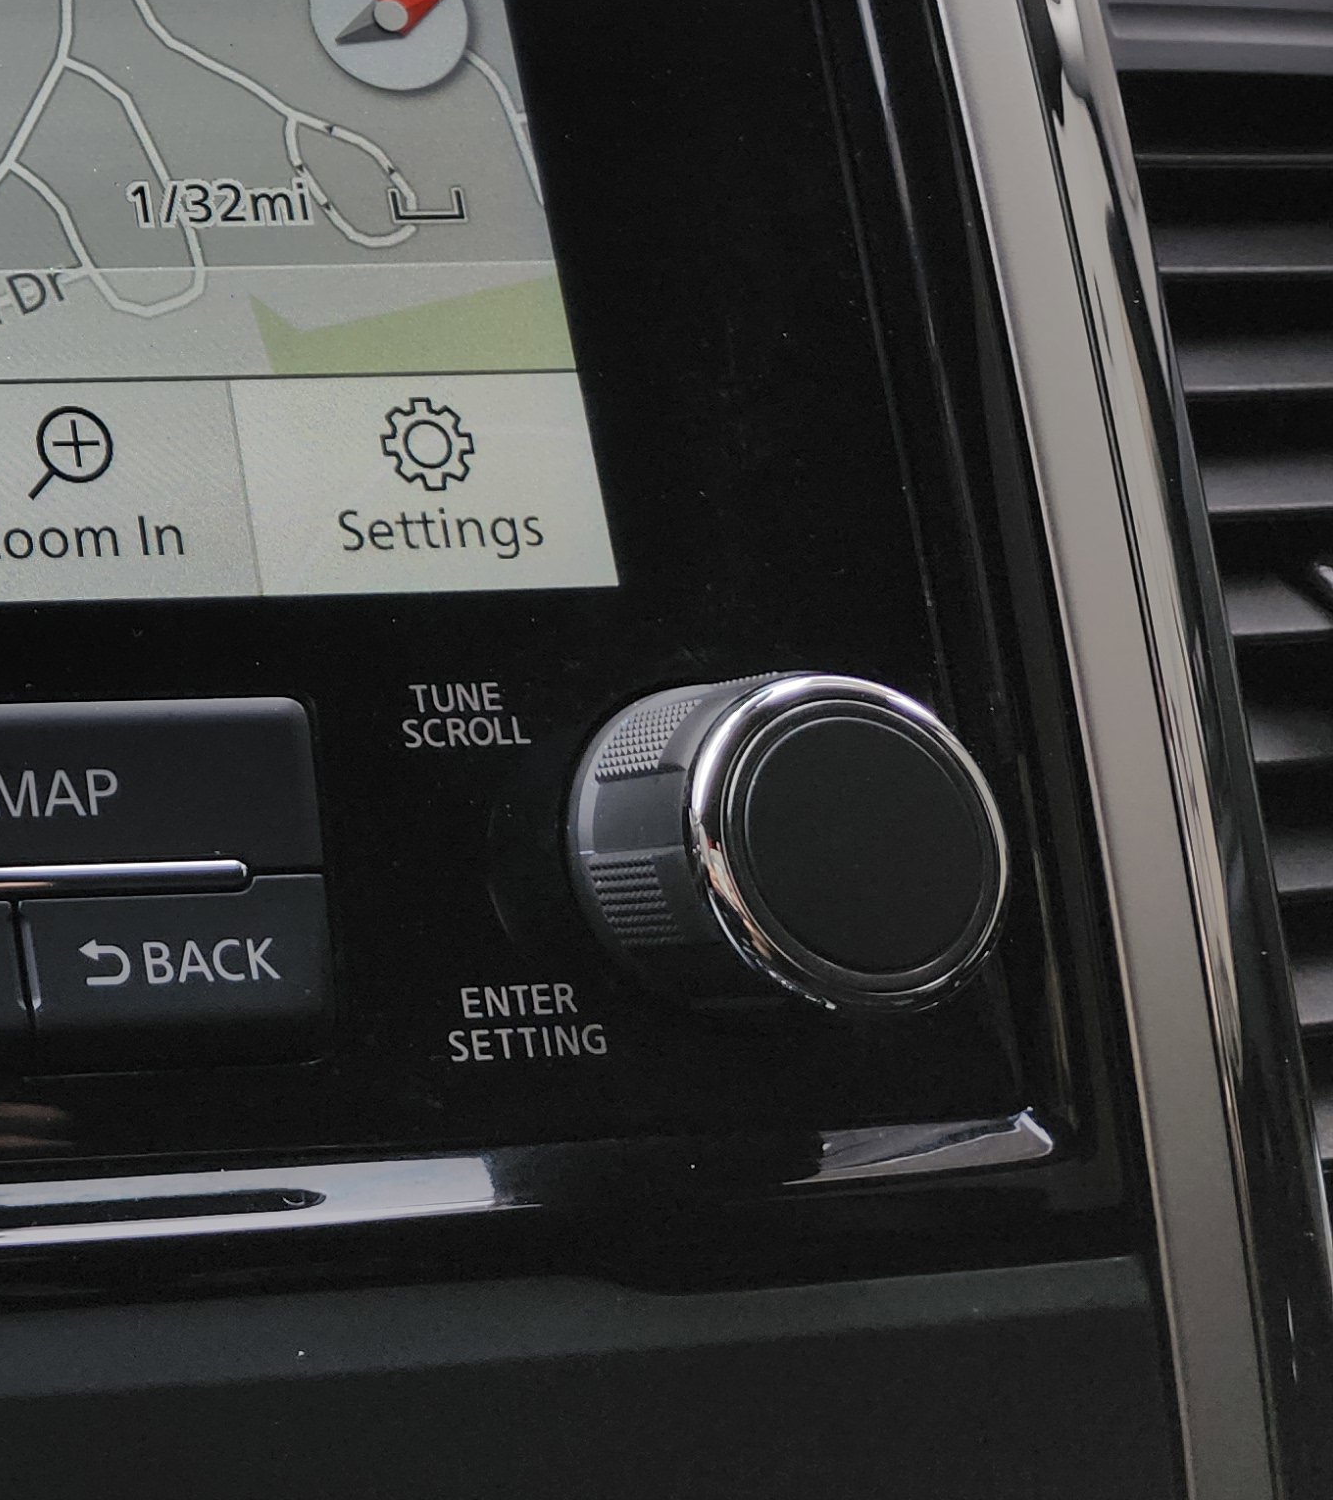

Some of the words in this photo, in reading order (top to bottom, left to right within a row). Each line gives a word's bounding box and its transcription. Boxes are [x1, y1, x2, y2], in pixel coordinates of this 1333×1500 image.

[130, 182, 309, 224] 1/32mi
[7, 271, 66, 315] Dr
[138, 517, 185, 558] In
[338, 509, 544, 560] Settings
[409, 682, 503, 713] TUNE
[402, 714, 531, 749] SCROLL
[143, 934, 281, 988] BACK
[462, 982, 579, 1020] ENTER
[447, 1023, 608, 1064] SETTING
